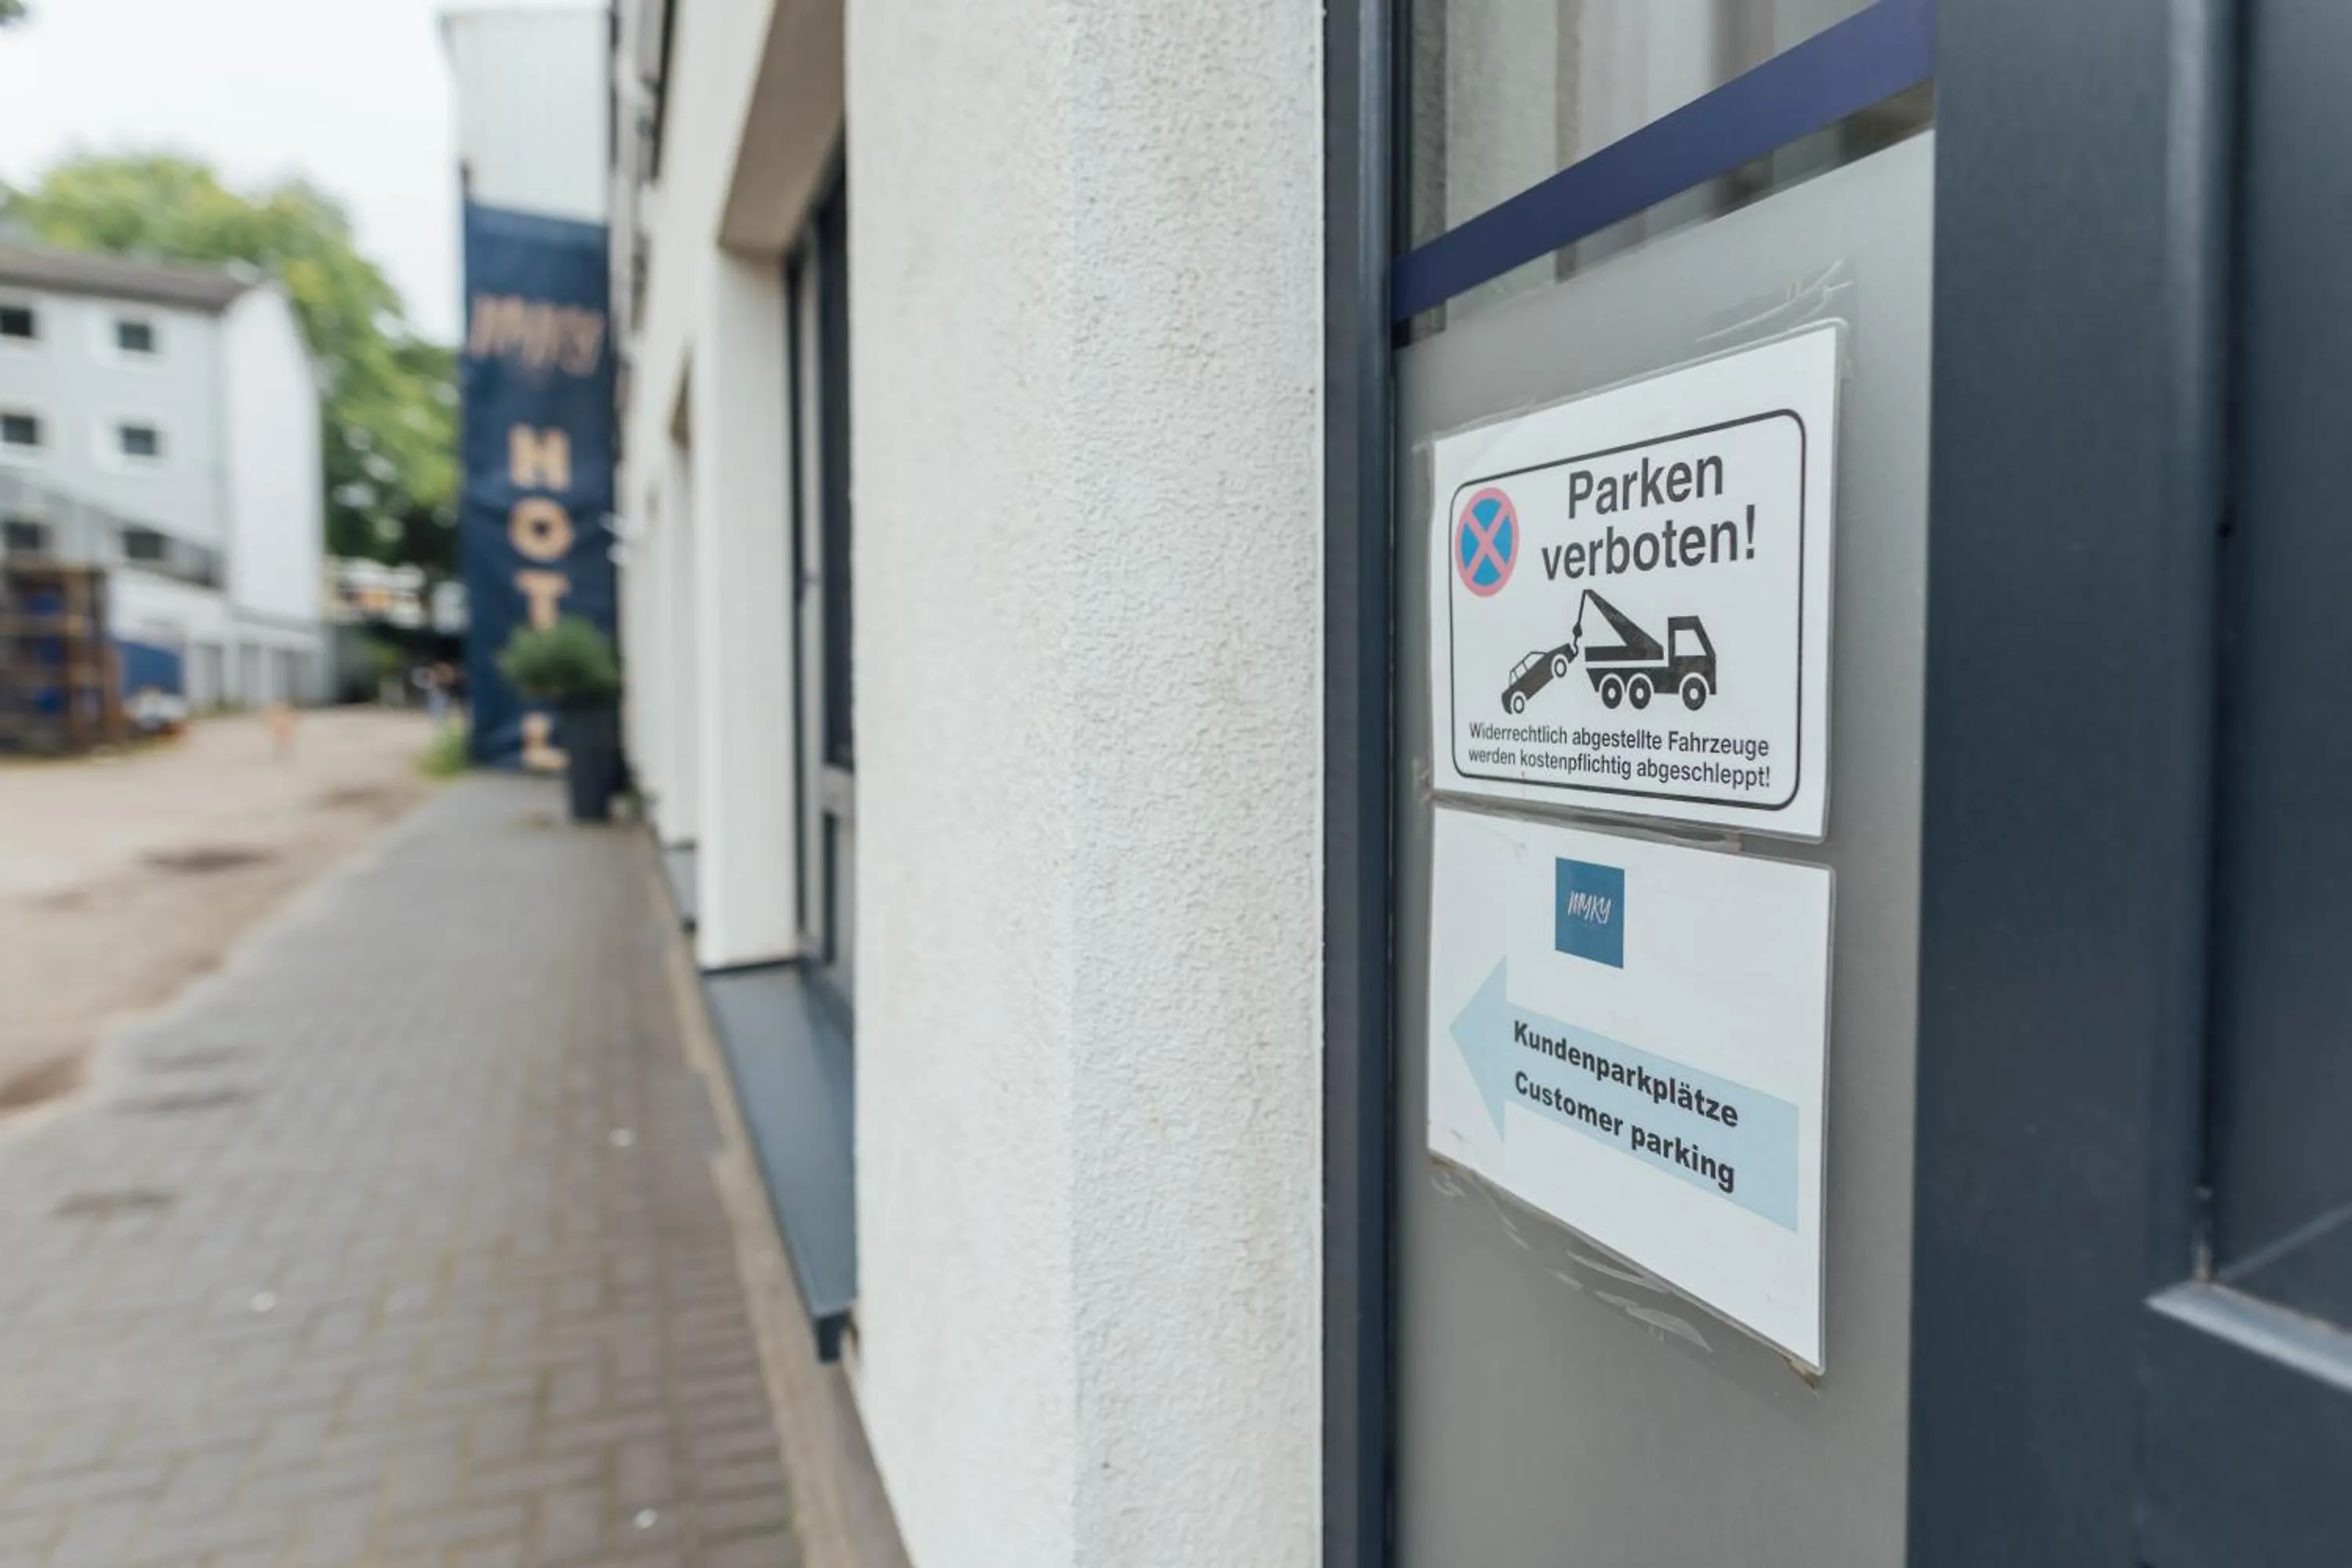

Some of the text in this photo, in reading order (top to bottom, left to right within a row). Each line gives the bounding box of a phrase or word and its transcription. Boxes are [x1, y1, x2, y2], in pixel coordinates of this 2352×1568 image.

[1568, 455, 1723, 519] Parken
[1541, 504, 1755, 580] verboten!
[508, 423, 572, 770] HOTL
[1468, 722, 1769, 760] Widerrechtlich abgestellte Fahrzeuge
[1468, 747, 1770, 790] werden kostenpflichtig abgeschleppt!
[1513, 1020, 1739, 1127] Kundenparkplätze
[1514, 1071, 1735, 1194] Customer parking
